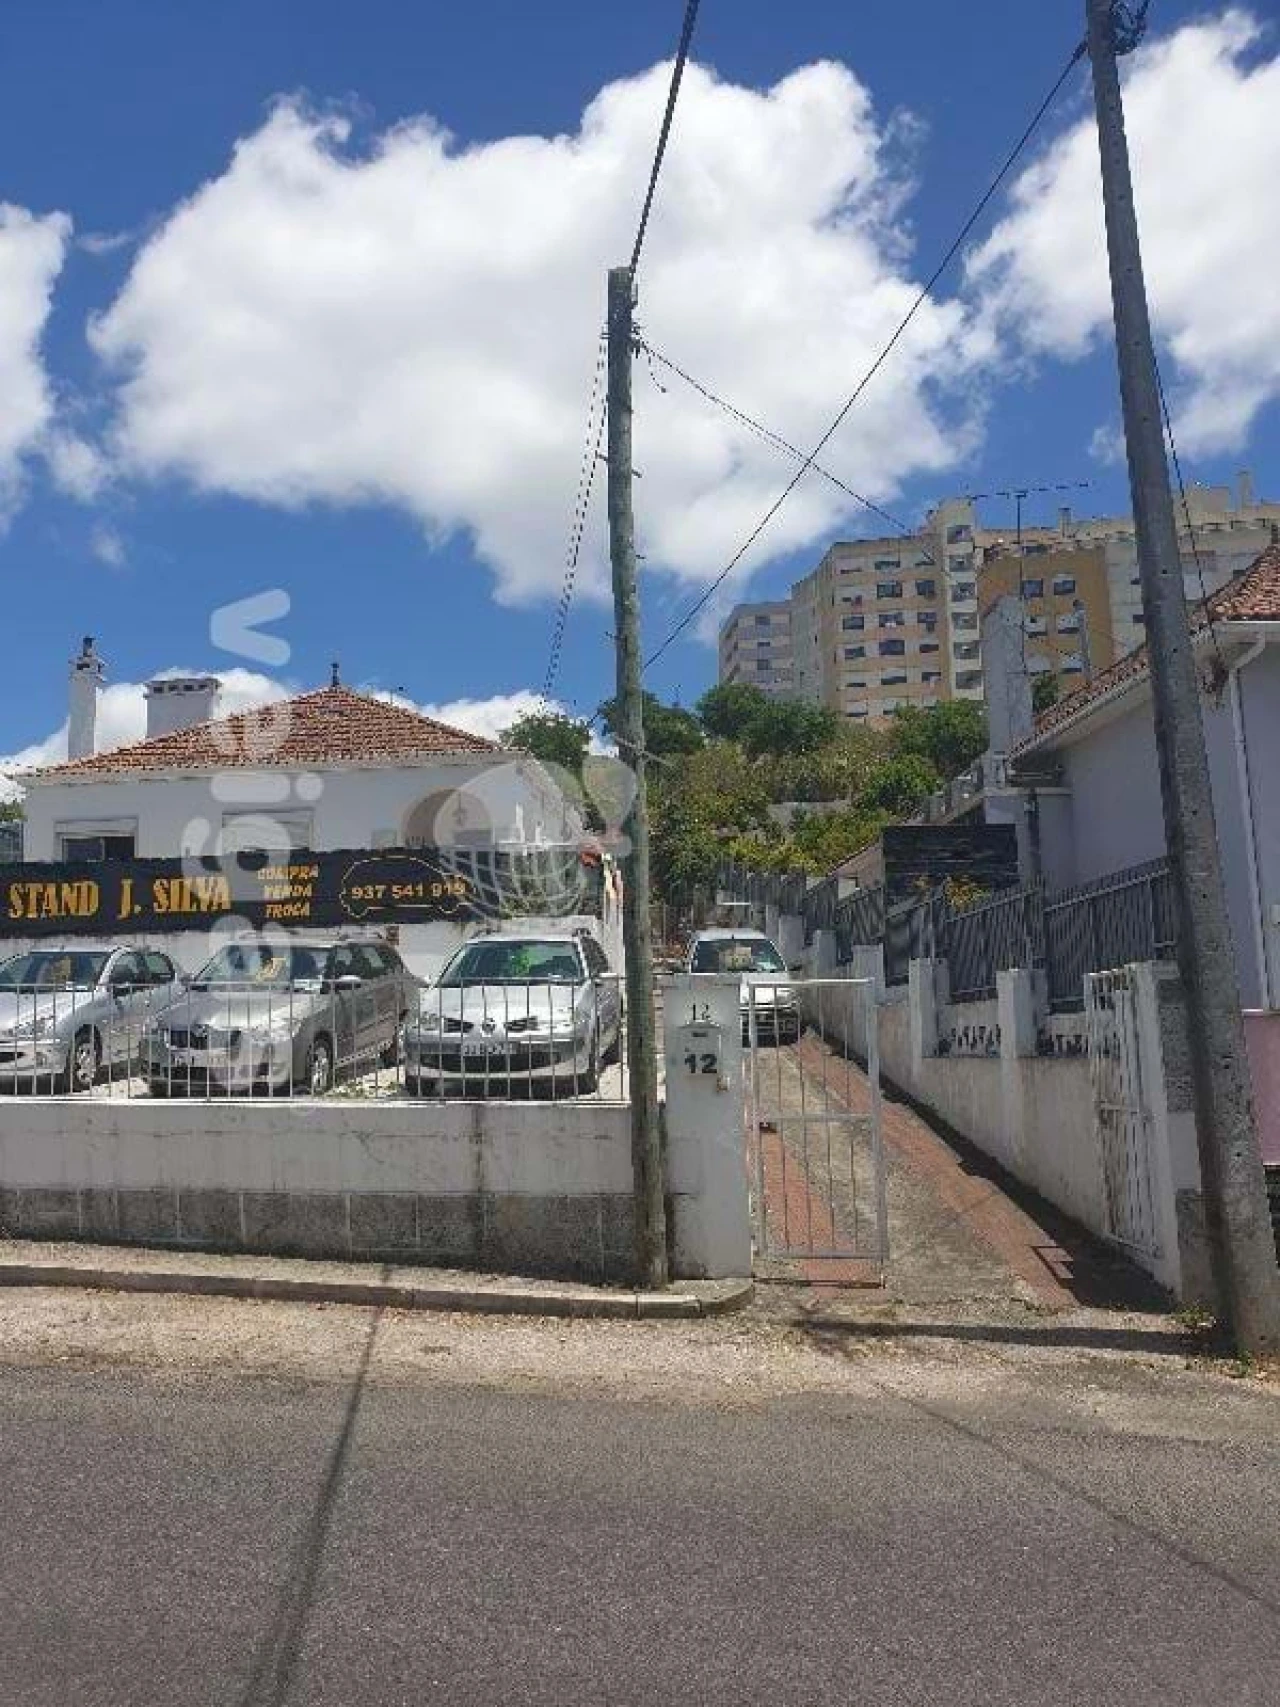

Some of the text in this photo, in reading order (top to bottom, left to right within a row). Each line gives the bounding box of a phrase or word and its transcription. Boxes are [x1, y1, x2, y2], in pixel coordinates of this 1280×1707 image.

[9, 876, 231, 919] STAND J. SILVA
[351, 884, 386, 899] 937
[391, 883, 423, 899] 541
[265, 902, 310, 918] TROCA
[684, 1053, 718, 1074] 12
